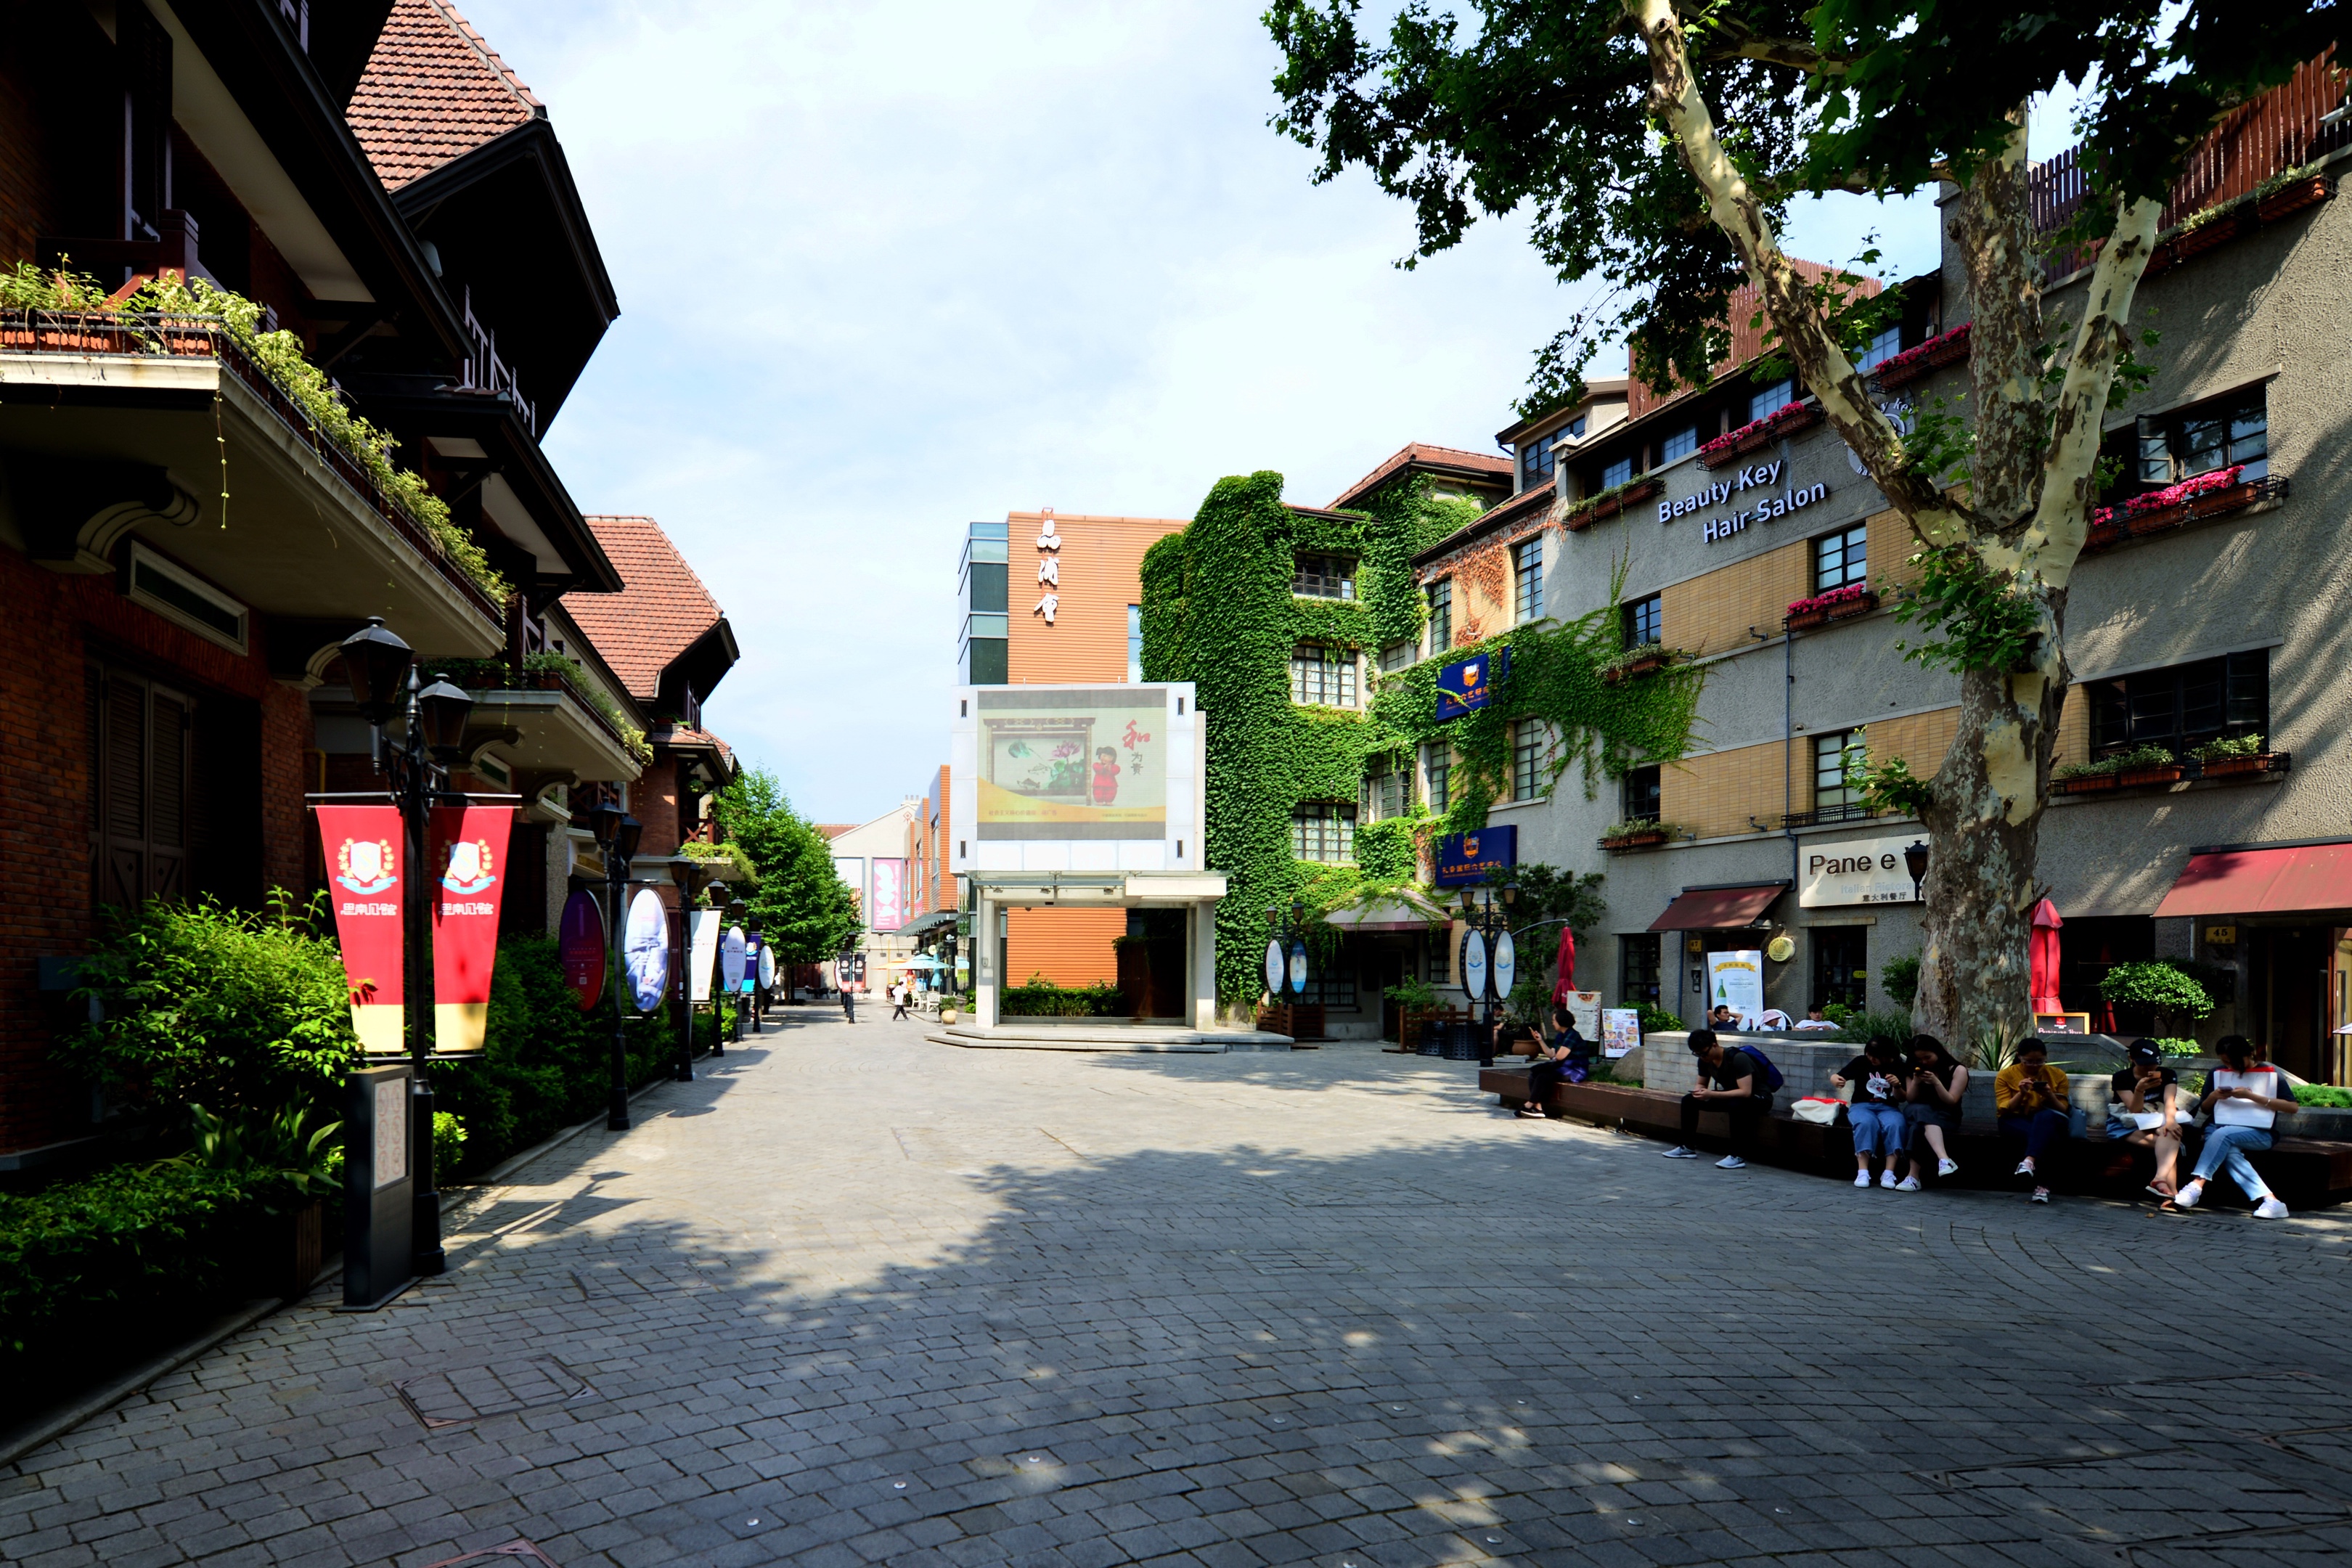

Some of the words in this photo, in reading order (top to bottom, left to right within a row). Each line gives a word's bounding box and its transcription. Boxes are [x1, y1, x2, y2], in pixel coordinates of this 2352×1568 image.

[1659, 480, 1733, 523] Beauty
[1739, 460, 1782, 491] Key
[1704, 511, 1750, 544] Hair
[1757, 483, 1826, 522] Salon
[1810, 855, 1872, 875] Pane
[1880, 853, 1896, 870] e
[1862, 891, 1907, 902] 意大利餐厅
